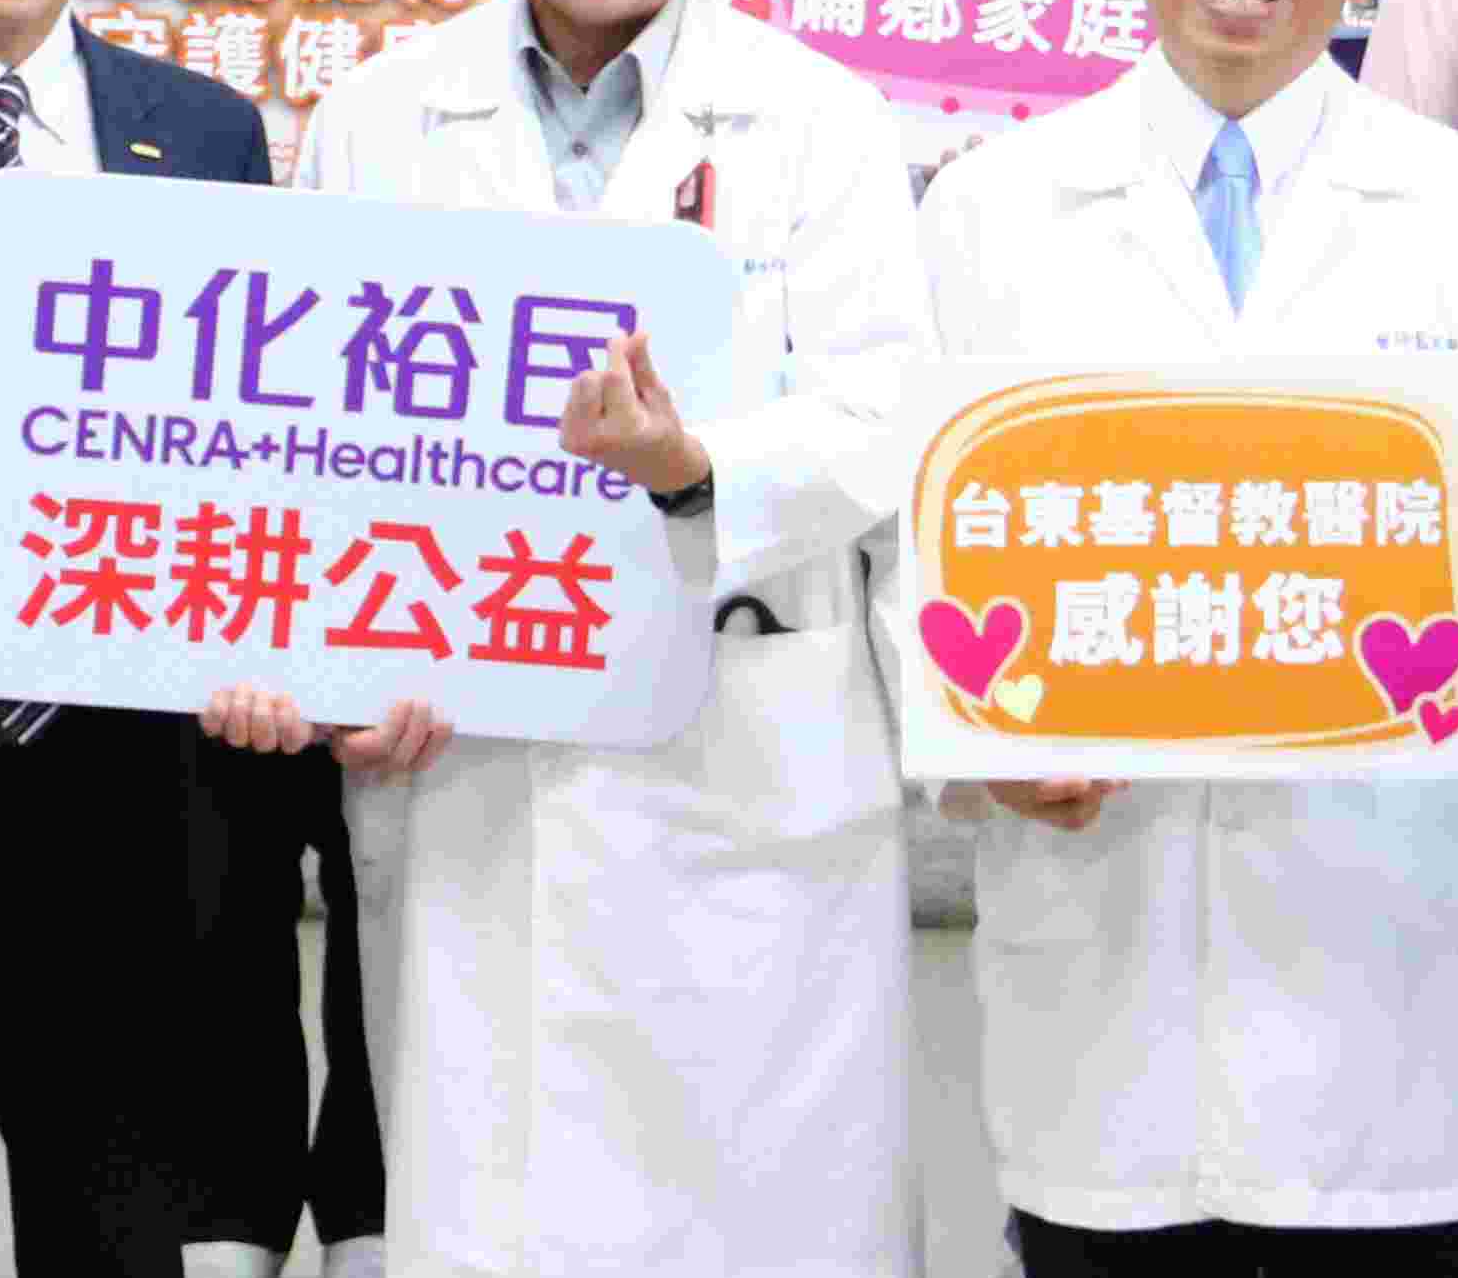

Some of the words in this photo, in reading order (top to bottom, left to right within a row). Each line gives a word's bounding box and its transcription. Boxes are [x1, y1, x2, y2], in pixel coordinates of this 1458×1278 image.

[34, 258, 638, 429] 中化裕民
[21, 405, 634, 502] CENRA+Healthcare
[951, 479, 1443, 548] 台東基督教醫院
[16, 492, 614, 671] 深耕公益
[1049, 571, 1345, 666] 感謝您
